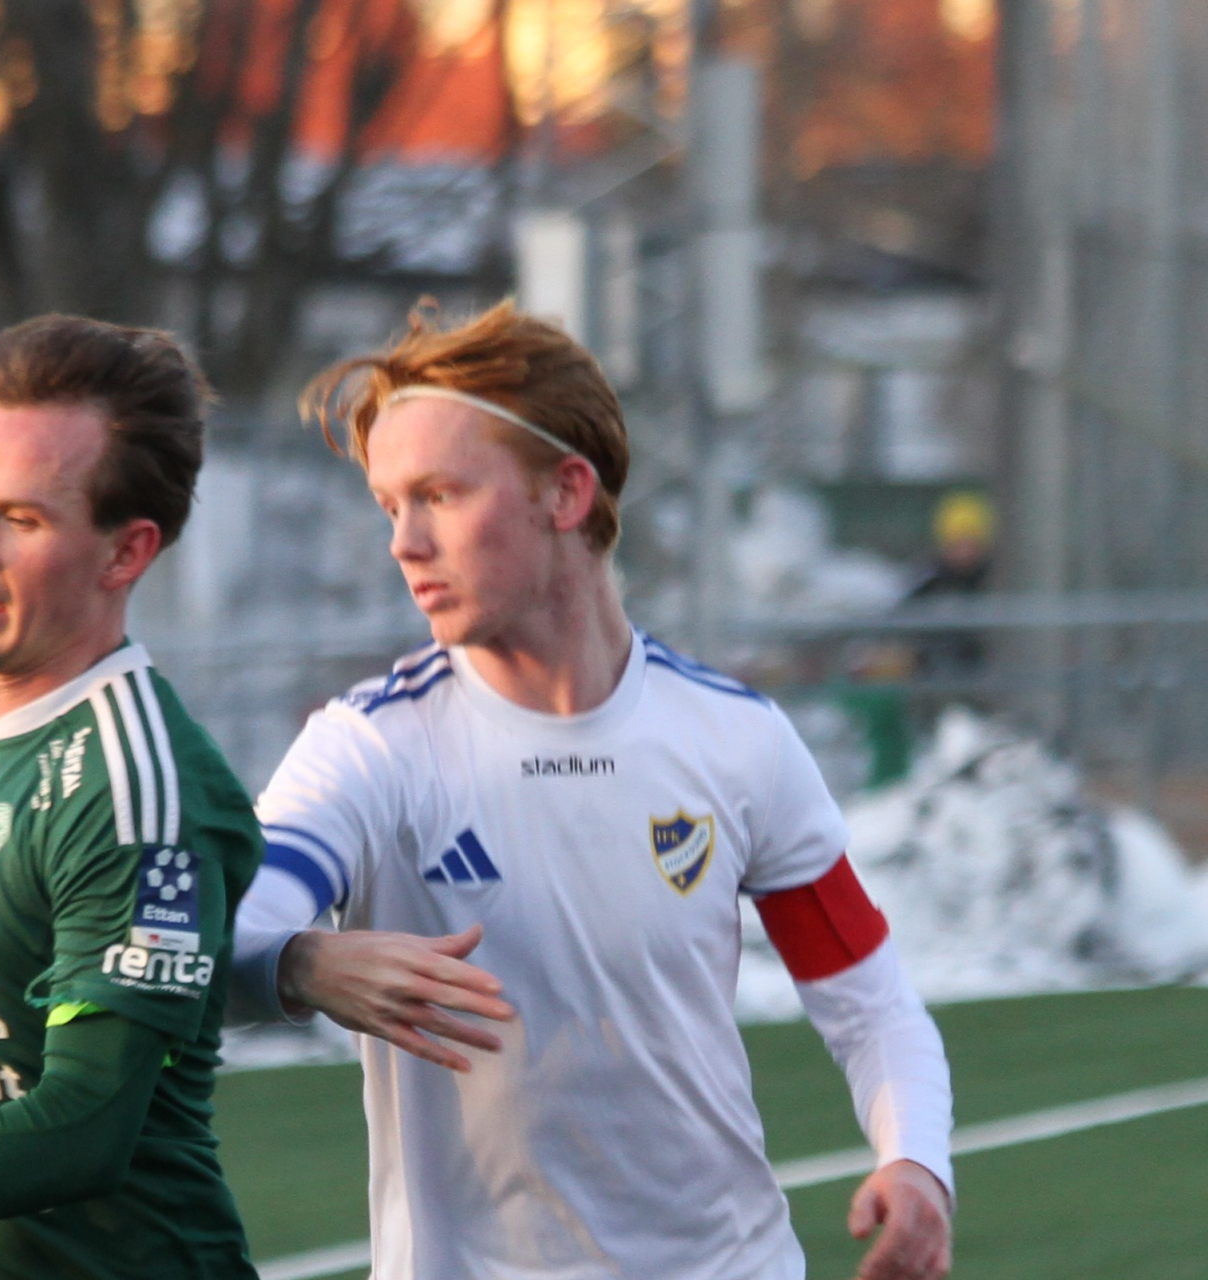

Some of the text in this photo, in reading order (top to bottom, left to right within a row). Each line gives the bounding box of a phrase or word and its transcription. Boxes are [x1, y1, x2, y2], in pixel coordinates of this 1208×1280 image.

[521, 755, 615, 778] stadium
[143, 904, 190, 924] Ettan
[101, 944, 214, 986] renta
